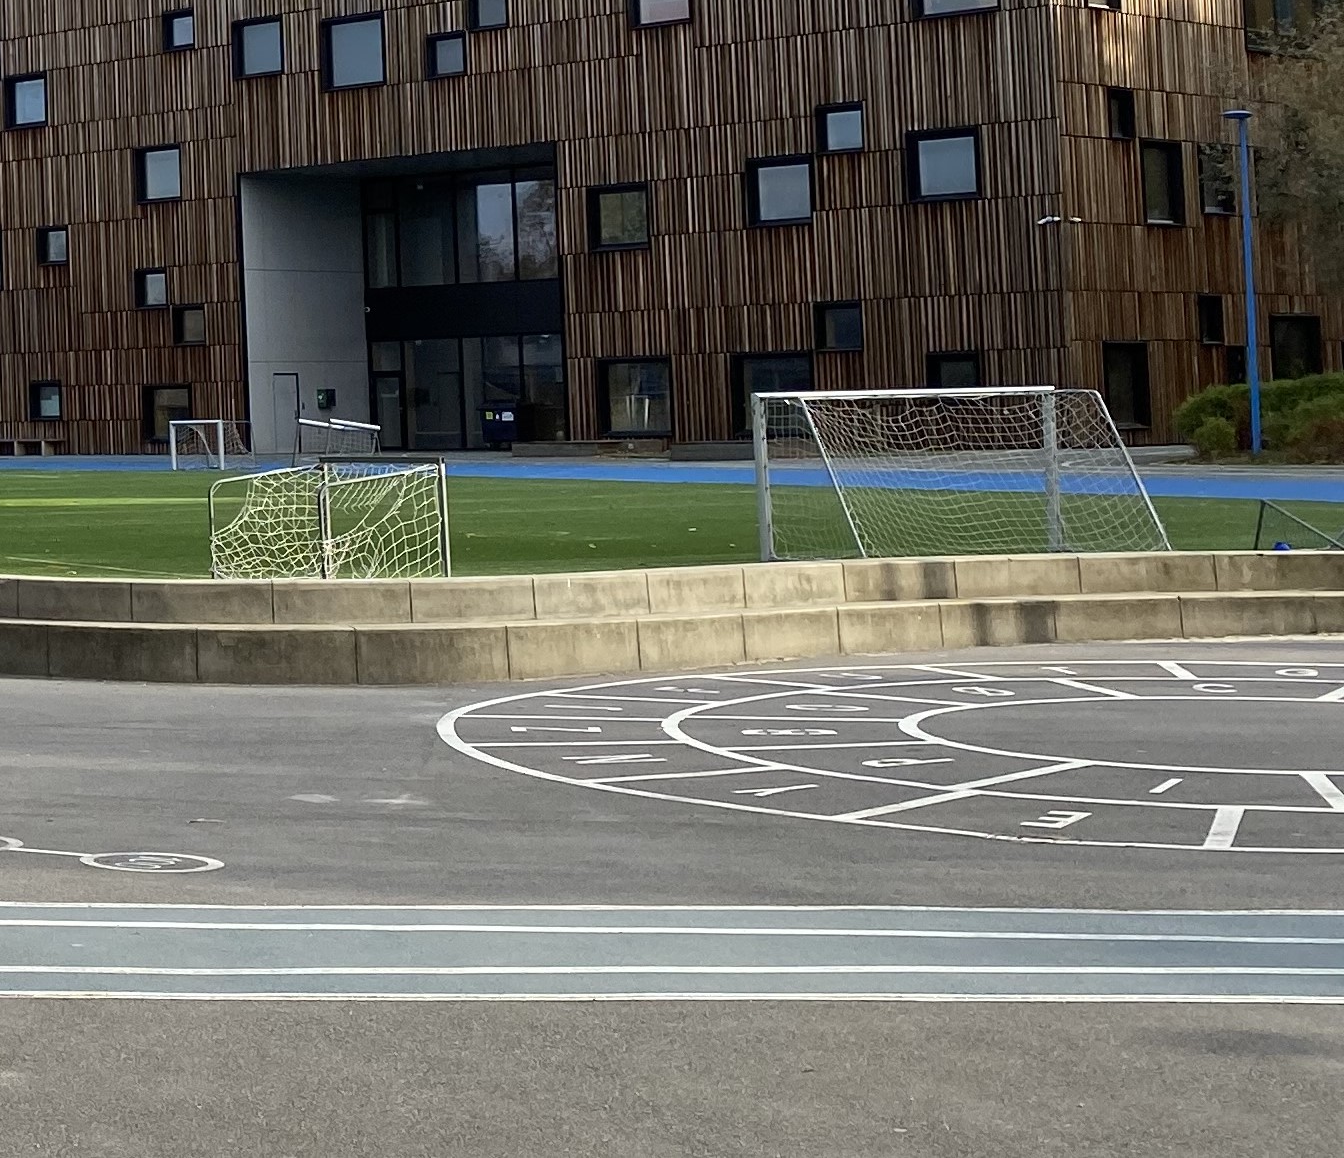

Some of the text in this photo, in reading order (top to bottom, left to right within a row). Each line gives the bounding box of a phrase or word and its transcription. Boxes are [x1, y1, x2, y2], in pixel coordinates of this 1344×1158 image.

[1193, 683, 1239, 693] C
[731, 784, 820, 797] Y
[1019, 809, 1093, 829] E
